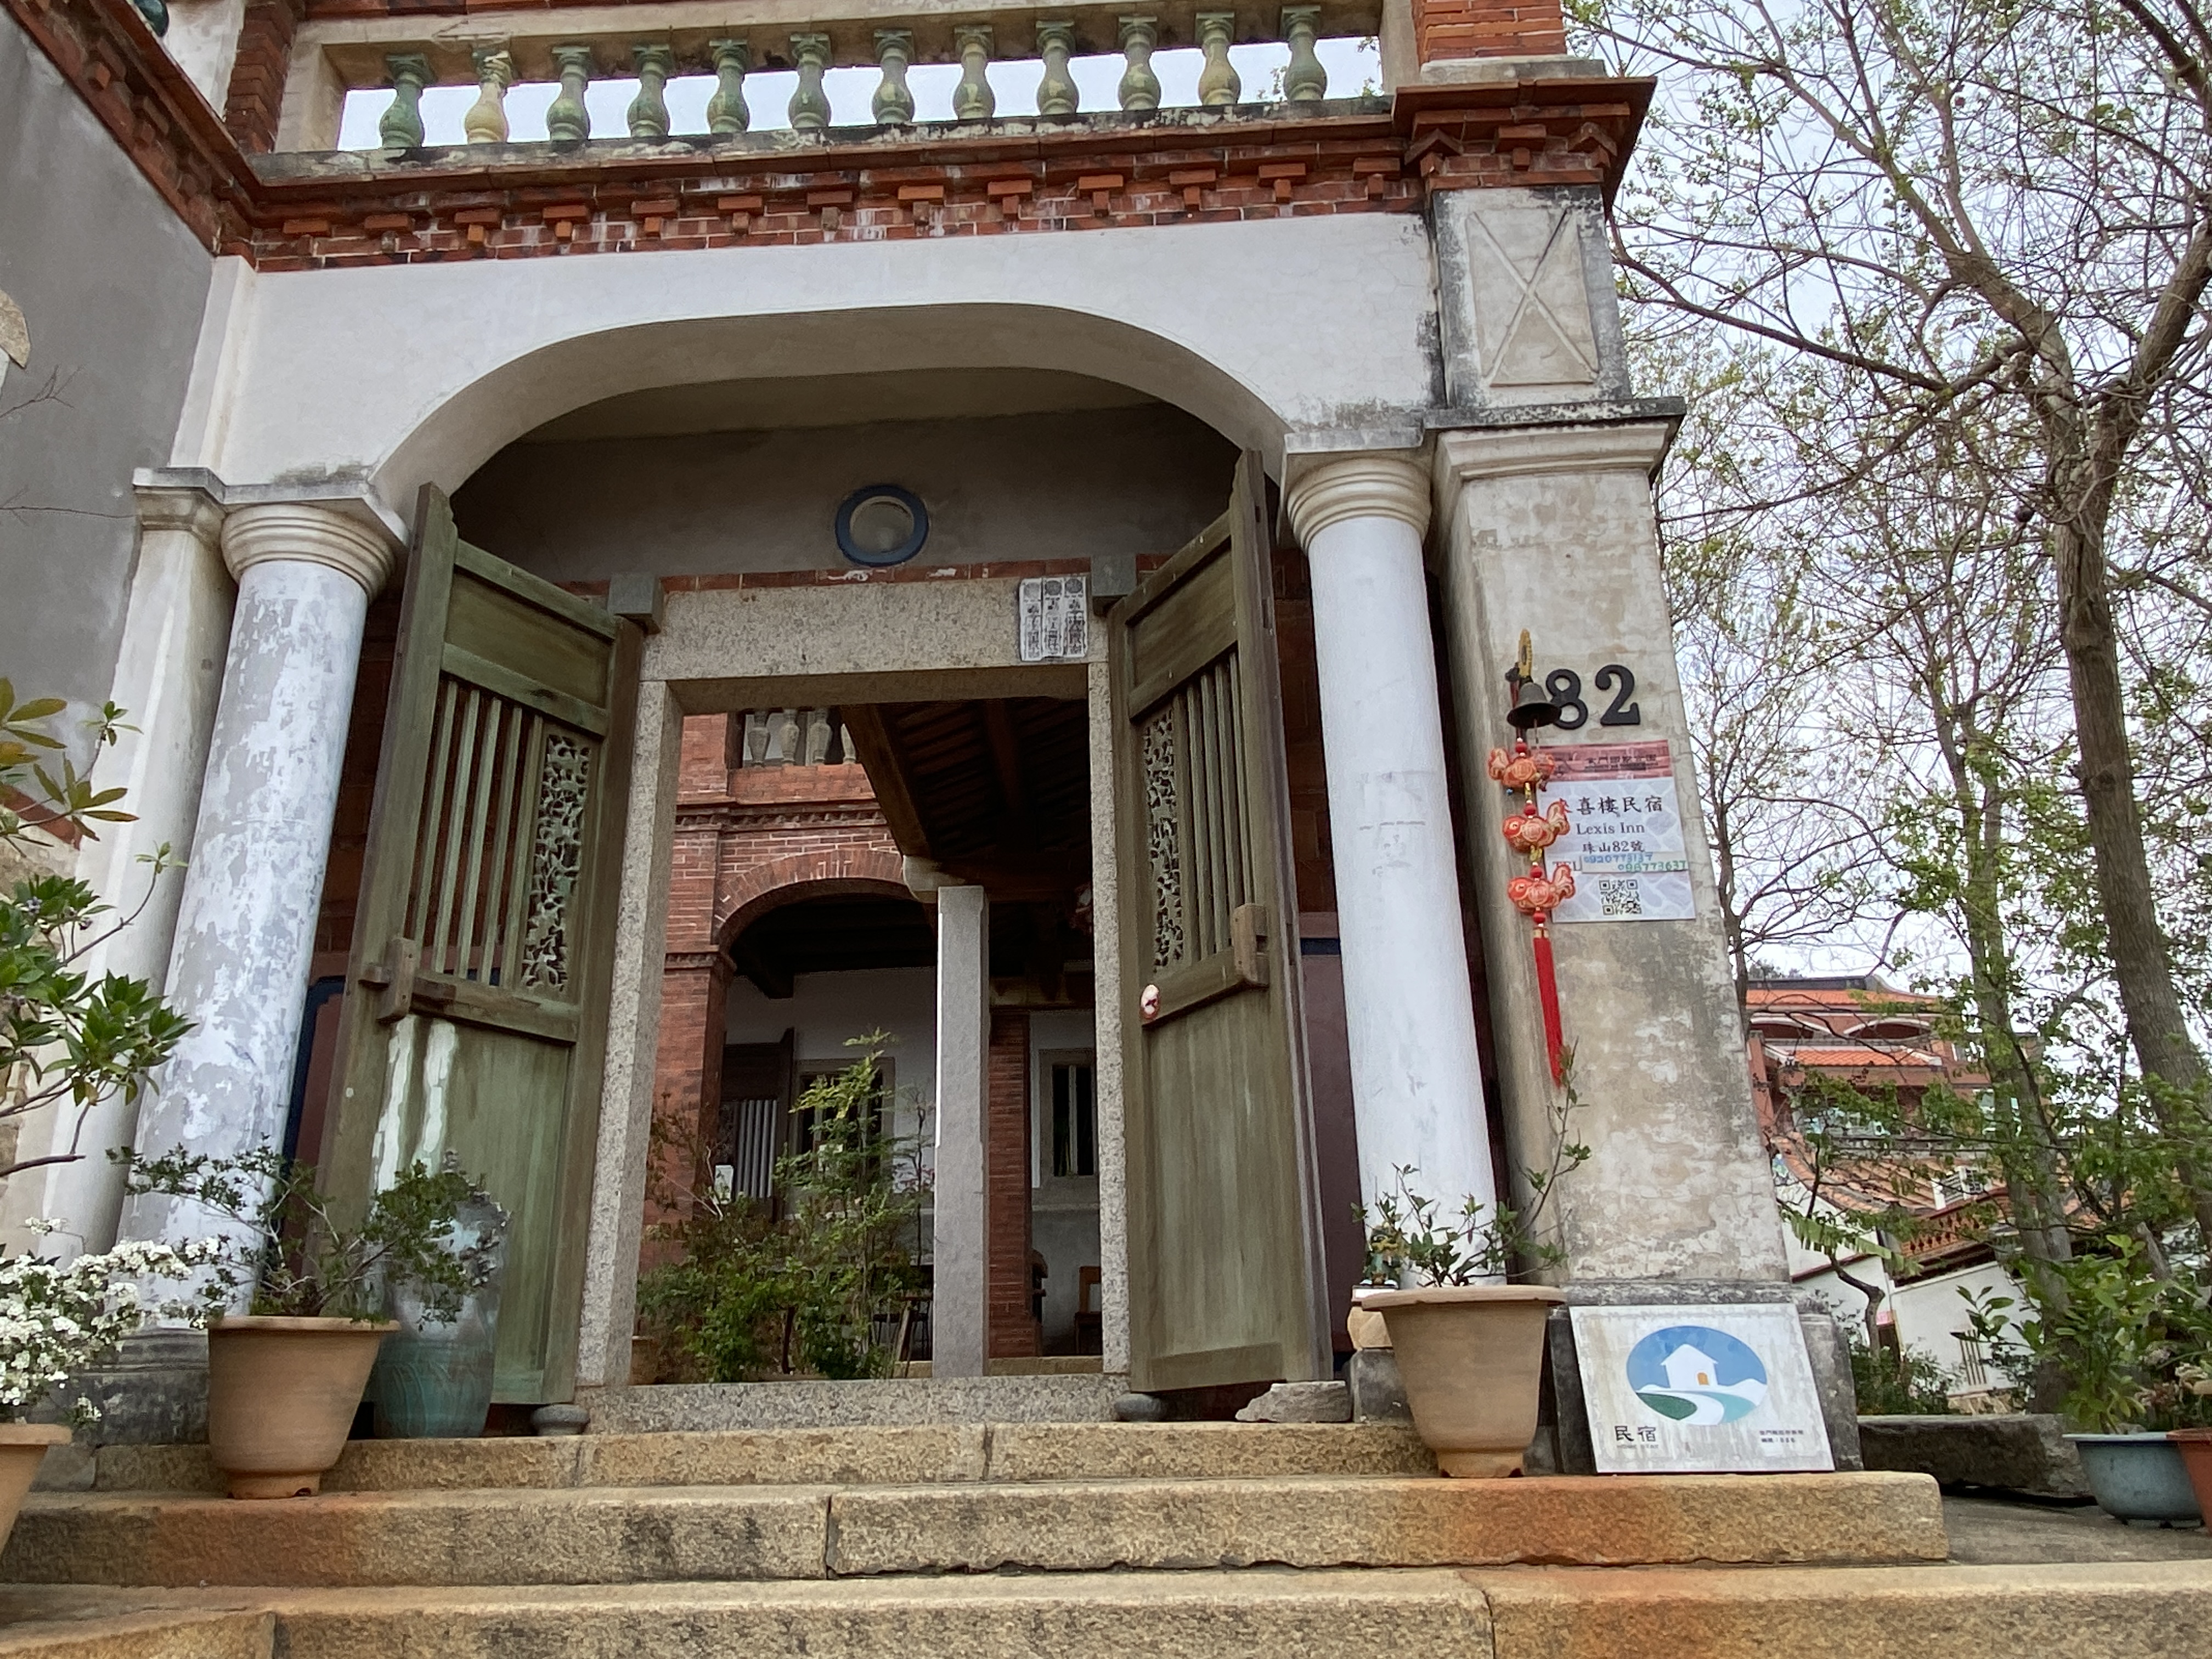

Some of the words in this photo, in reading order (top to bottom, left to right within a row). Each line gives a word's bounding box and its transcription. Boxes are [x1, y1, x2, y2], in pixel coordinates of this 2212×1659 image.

[1545, 664, 1641, 730] 82
[1576, 795, 1662, 817] 喜樓民宿
[1576, 822, 1615, 835] Lexis
[1620, 822, 1645, 833] Inn
[1614, 1425, 1656, 1442] 民宿
